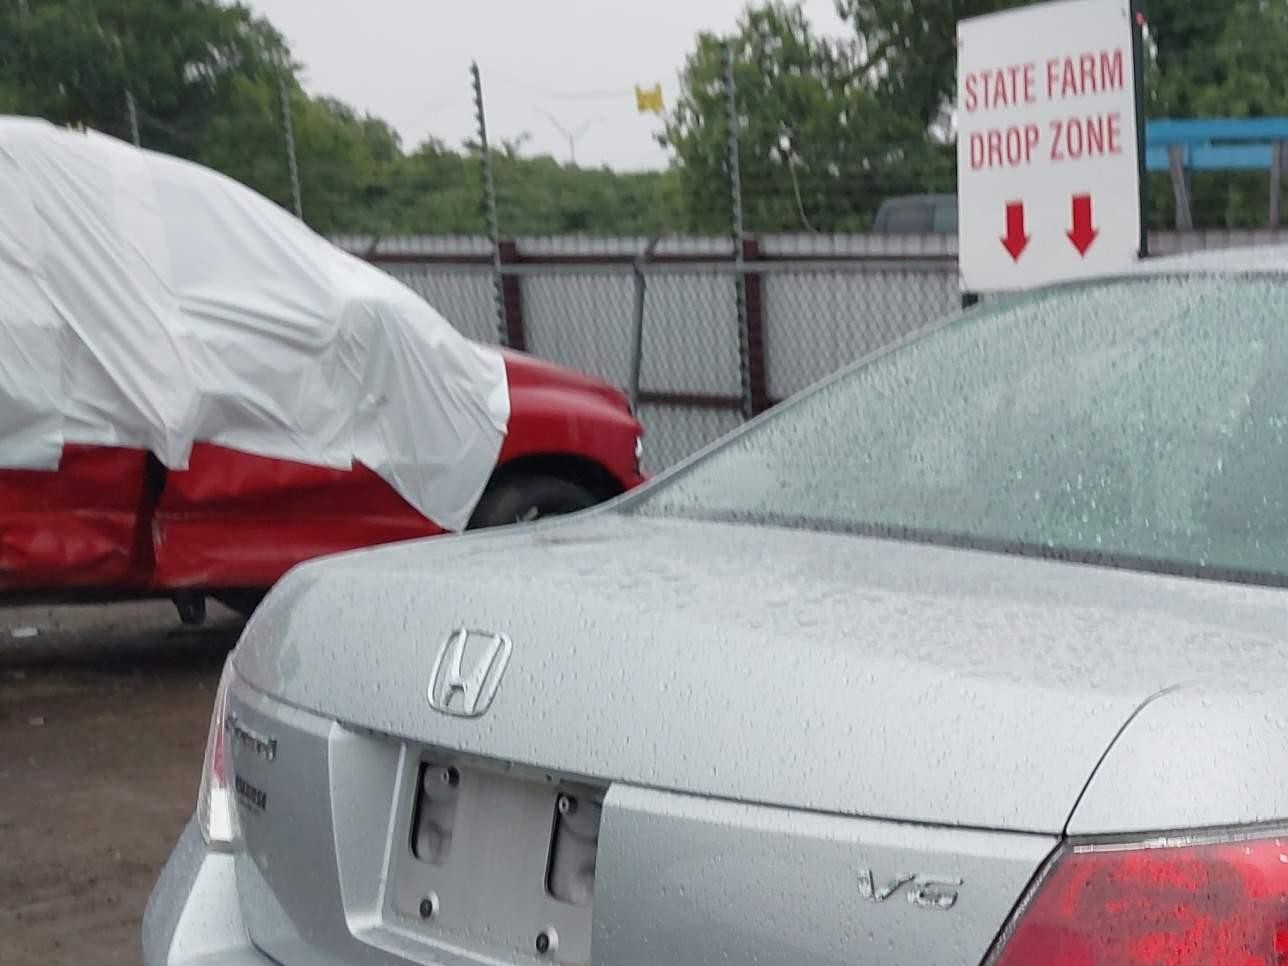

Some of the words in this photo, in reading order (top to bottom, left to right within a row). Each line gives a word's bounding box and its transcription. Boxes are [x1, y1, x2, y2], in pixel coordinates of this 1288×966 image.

[964, 62, 1036, 113] STATE
[1046, 47, 1125, 99] FARM
[970, 123, 1039, 171] DROP
[1049, 111, 1121, 161] ZONE
[857, 869, 963, 911] V6
